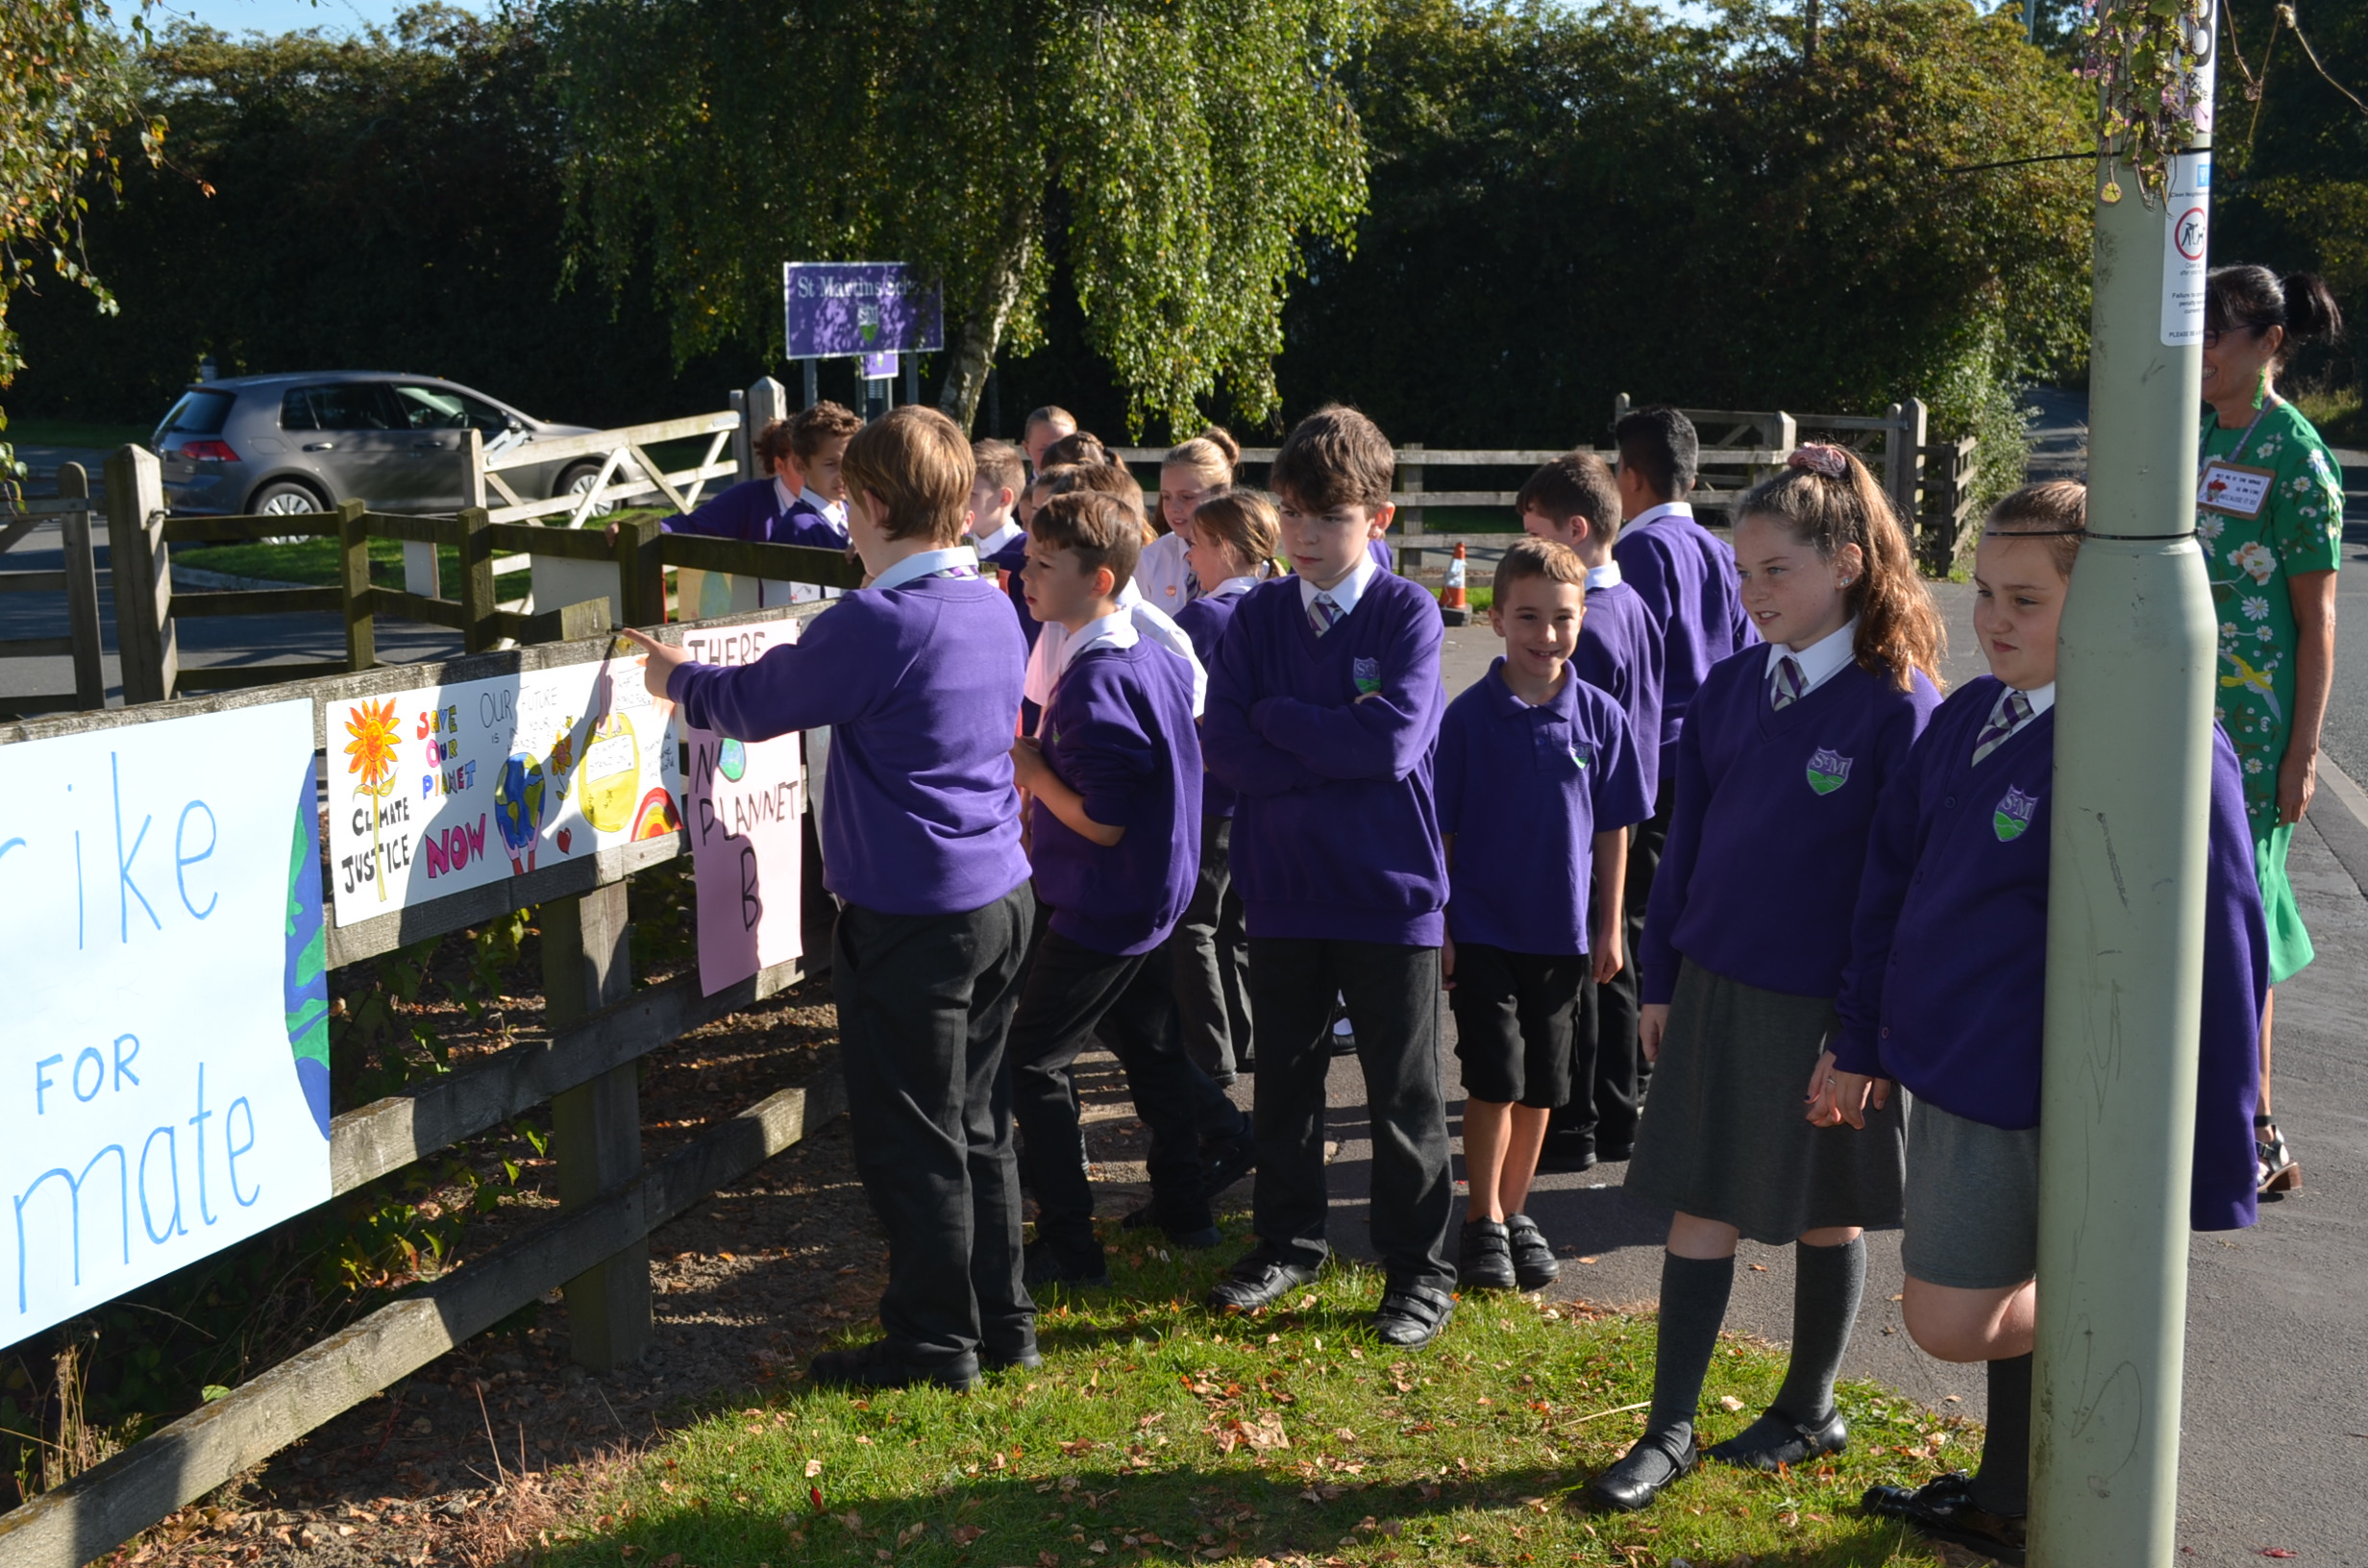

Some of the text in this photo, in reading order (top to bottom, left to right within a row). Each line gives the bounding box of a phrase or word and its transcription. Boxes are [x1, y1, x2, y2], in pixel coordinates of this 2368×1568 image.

[798, 276, 815, 298] St
[820, 275, 882, 298] Martins
[687, 631, 766, 667] THERE
[417, 704, 458, 740] SAVE
[481, 689, 513, 728] OUR
[426, 738, 458, 768] OUR
[700, 780, 799, 846] PLANNET
[341, 833, 410, 894] JUSTICE
[425, 813, 486, 879] NOW
[740, 846, 759, 932] B
[37, 1033, 140, 1115] FOR
